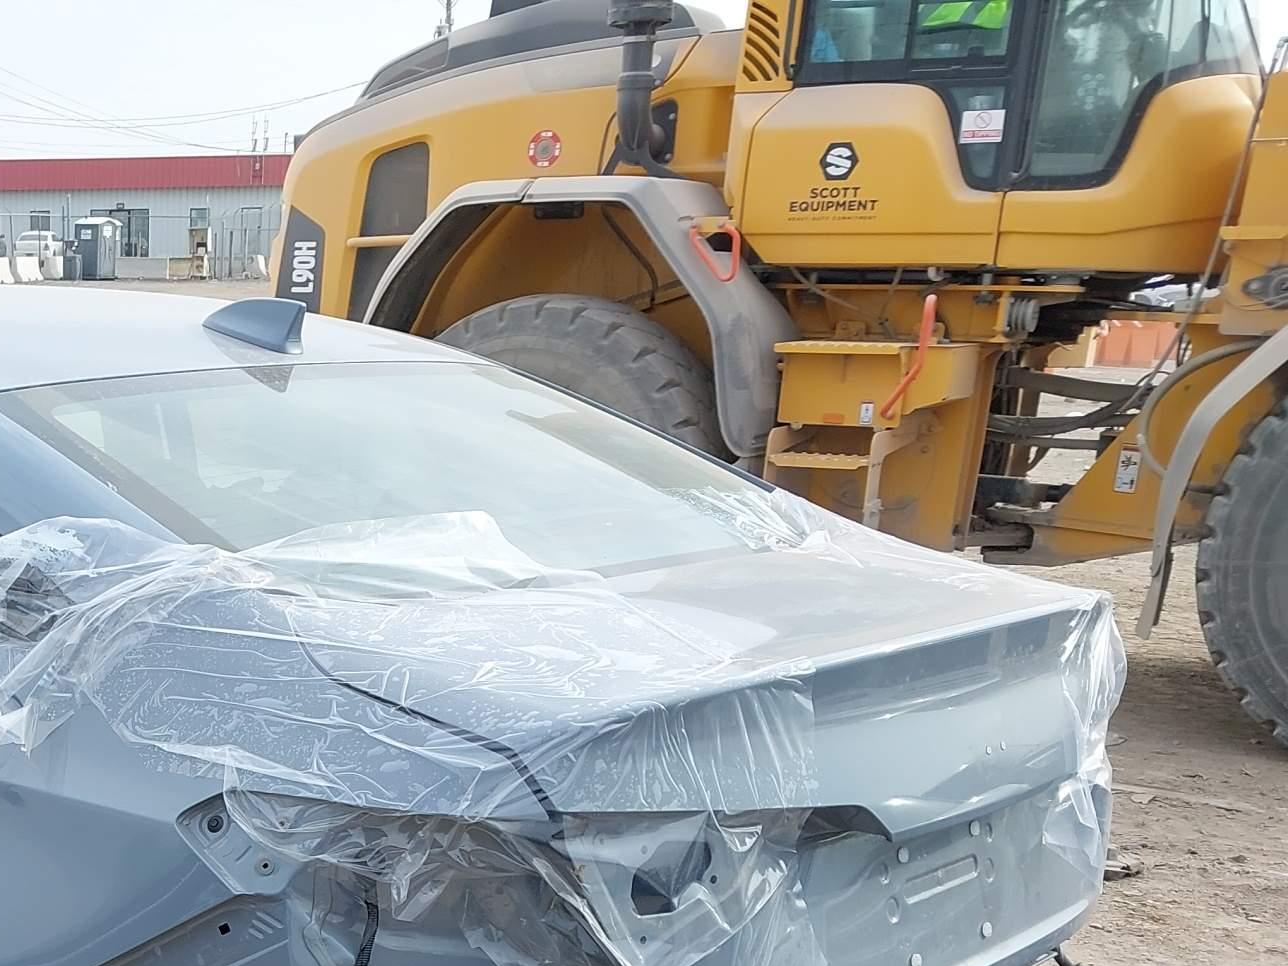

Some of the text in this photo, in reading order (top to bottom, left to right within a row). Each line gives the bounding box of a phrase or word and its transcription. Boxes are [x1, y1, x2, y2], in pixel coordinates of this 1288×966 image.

[810, 187, 861, 199] SCOTT
[789, 200, 879, 212] EQUIPMENT
[291, 241, 317, 293] L90H
